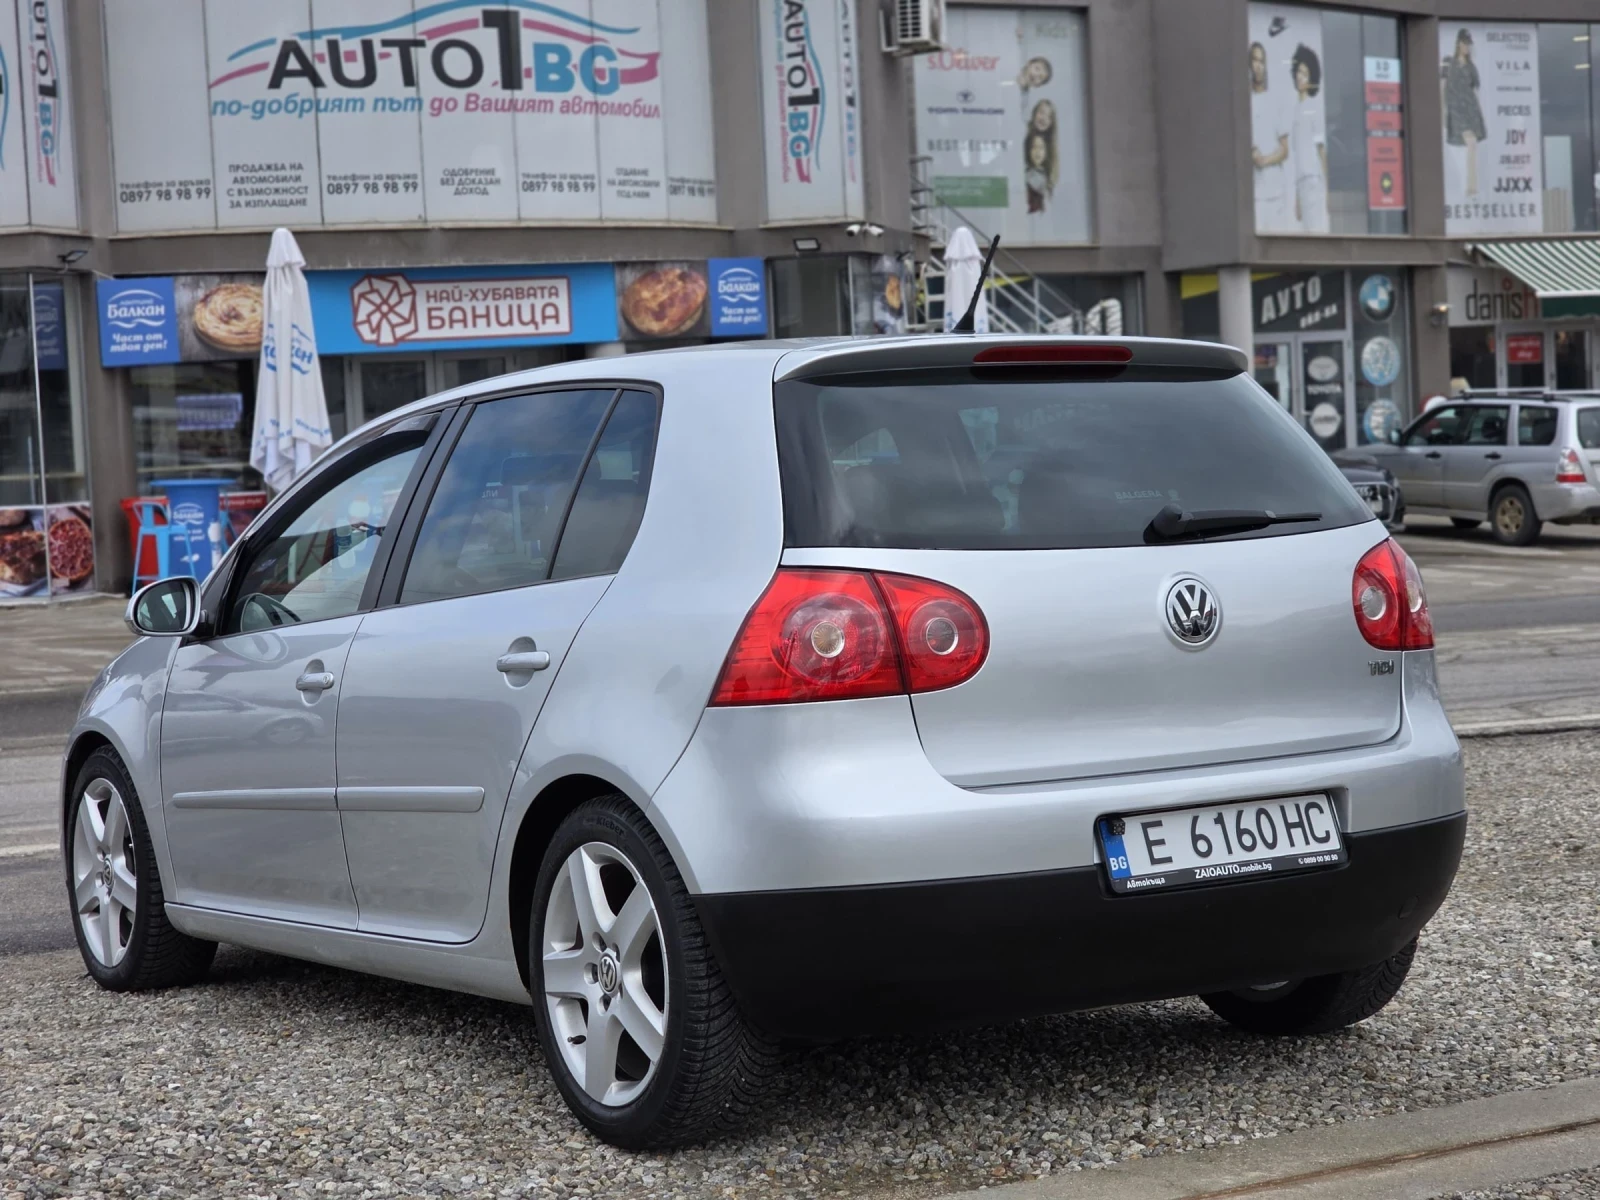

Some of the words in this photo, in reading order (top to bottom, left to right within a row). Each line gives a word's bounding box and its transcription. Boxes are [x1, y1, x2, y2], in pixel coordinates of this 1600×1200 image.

[1495, 60, 1531, 70] VILA
[33, 1, 58, 156] UTO1BG
[211, 92, 365, 120] по-добрият
[372, 96, 423, 113] път
[429, 97, 457, 117] до
[465, 94, 554, 113] Вашият
[560, 96, 660, 118] автомобил
[1497, 105, 1531, 116] PIECES
[1505, 129, 1527, 144] JDY
[228, 164, 286, 173] ПРОДАЖБА
[289, 163, 304, 172] НА
[442, 168, 495, 177] ОДОБРЕНИЕ
[232, 174, 302, 184] АВТОМОБИЛИ
[457, 177, 501, 187] ДОКАЗАН
[1493, 176, 1533, 193] JJXX
[227, 187, 235, 197] С
[237, 186, 309, 196] ВЪЗМОЖНОСТ
[327, 182, 359, 195] 0897
[363, 182, 379, 194] 98
[383, 181, 399, 193] 98
[404, 181, 418, 193] 99
[453, 187, 489, 196] ДОХОД
[522, 181, 547, 193] 0897
[551, 181, 564, 192] 98
[568, 181, 580, 192] 98
[583, 181, 596, 192] 99
[120, 190, 151, 203] 0897
[156, 189, 172, 200] 98
[176, 188, 192, 200] 98
[196, 187, 211, 199] 99
[229, 200, 242, 209] ЗА
[245, 198, 307, 209] ИЗПЛАЩАНЕ
[1444, 203, 1537, 219] BESTSELLER
[717, 280, 760, 293] Балкан
[426, 285, 560, 303] НАЙ-ХУБАВАТА
[107, 304, 165, 319] Балкан
[427, 303, 560, 330] БАНИЦА
[112, 333, 142, 343] Част
[110, 343, 140, 352] твоя
[1368, 659, 1394, 676] TDI
[595, 816, 624, 836] Kleber
[1140, 820, 1173, 866] E
[1109, 855, 1127, 870] BG
[1194, 862, 1272, 879] ZAIOAUTO.mobile.bg
[1126, 876, 1166, 889] Автокъща
